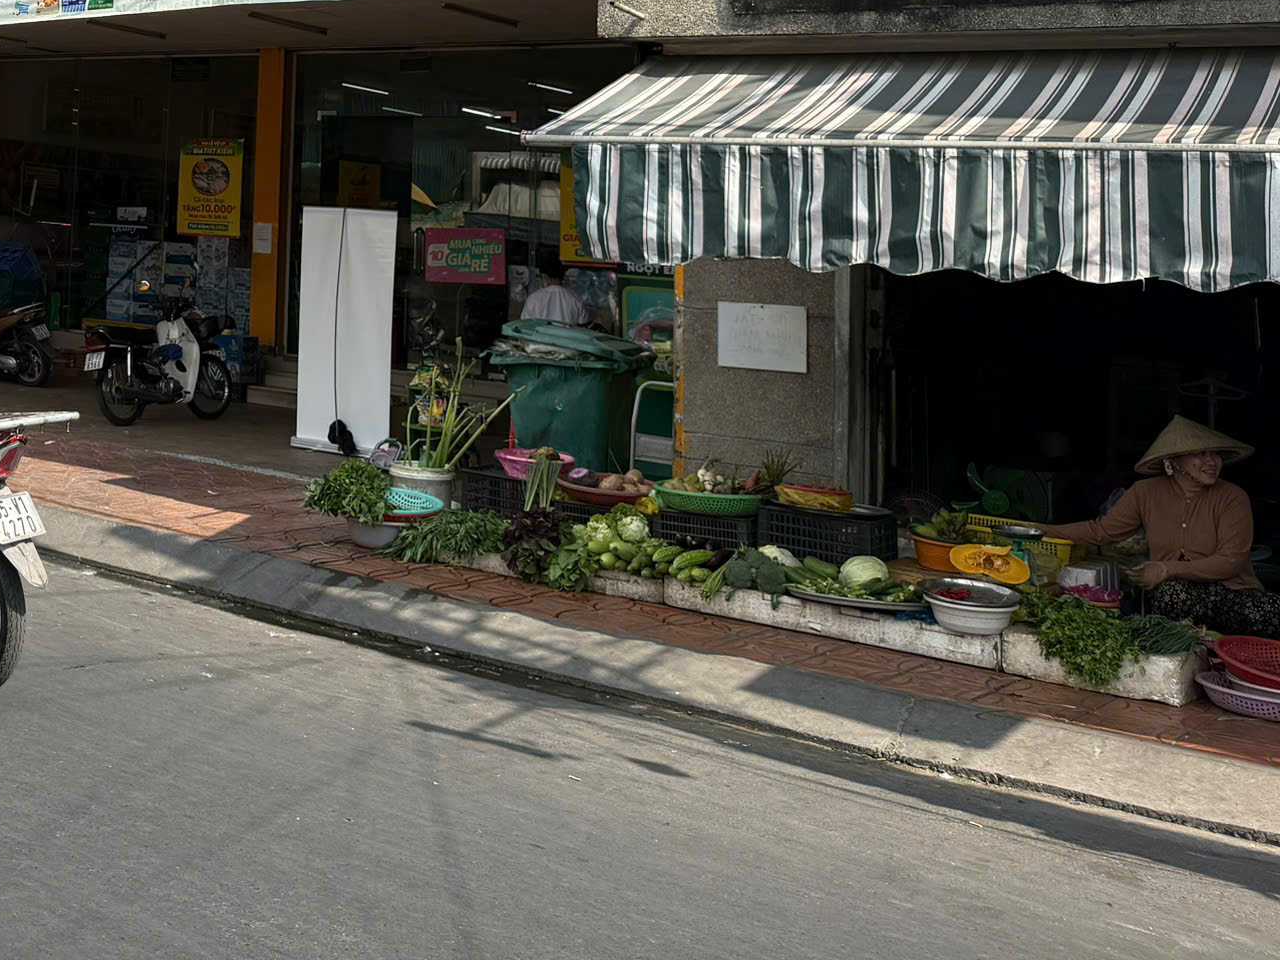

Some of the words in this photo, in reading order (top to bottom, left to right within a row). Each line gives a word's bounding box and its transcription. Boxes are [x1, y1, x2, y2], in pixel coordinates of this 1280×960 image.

[448, 239, 473, 249] MUA
[471, 242, 504, 255] NHIỀU
[447, 250, 473, 266] GIÁ
[471, 254, 489, 273] RẺ
[1, 515, 37, 539] 4270
